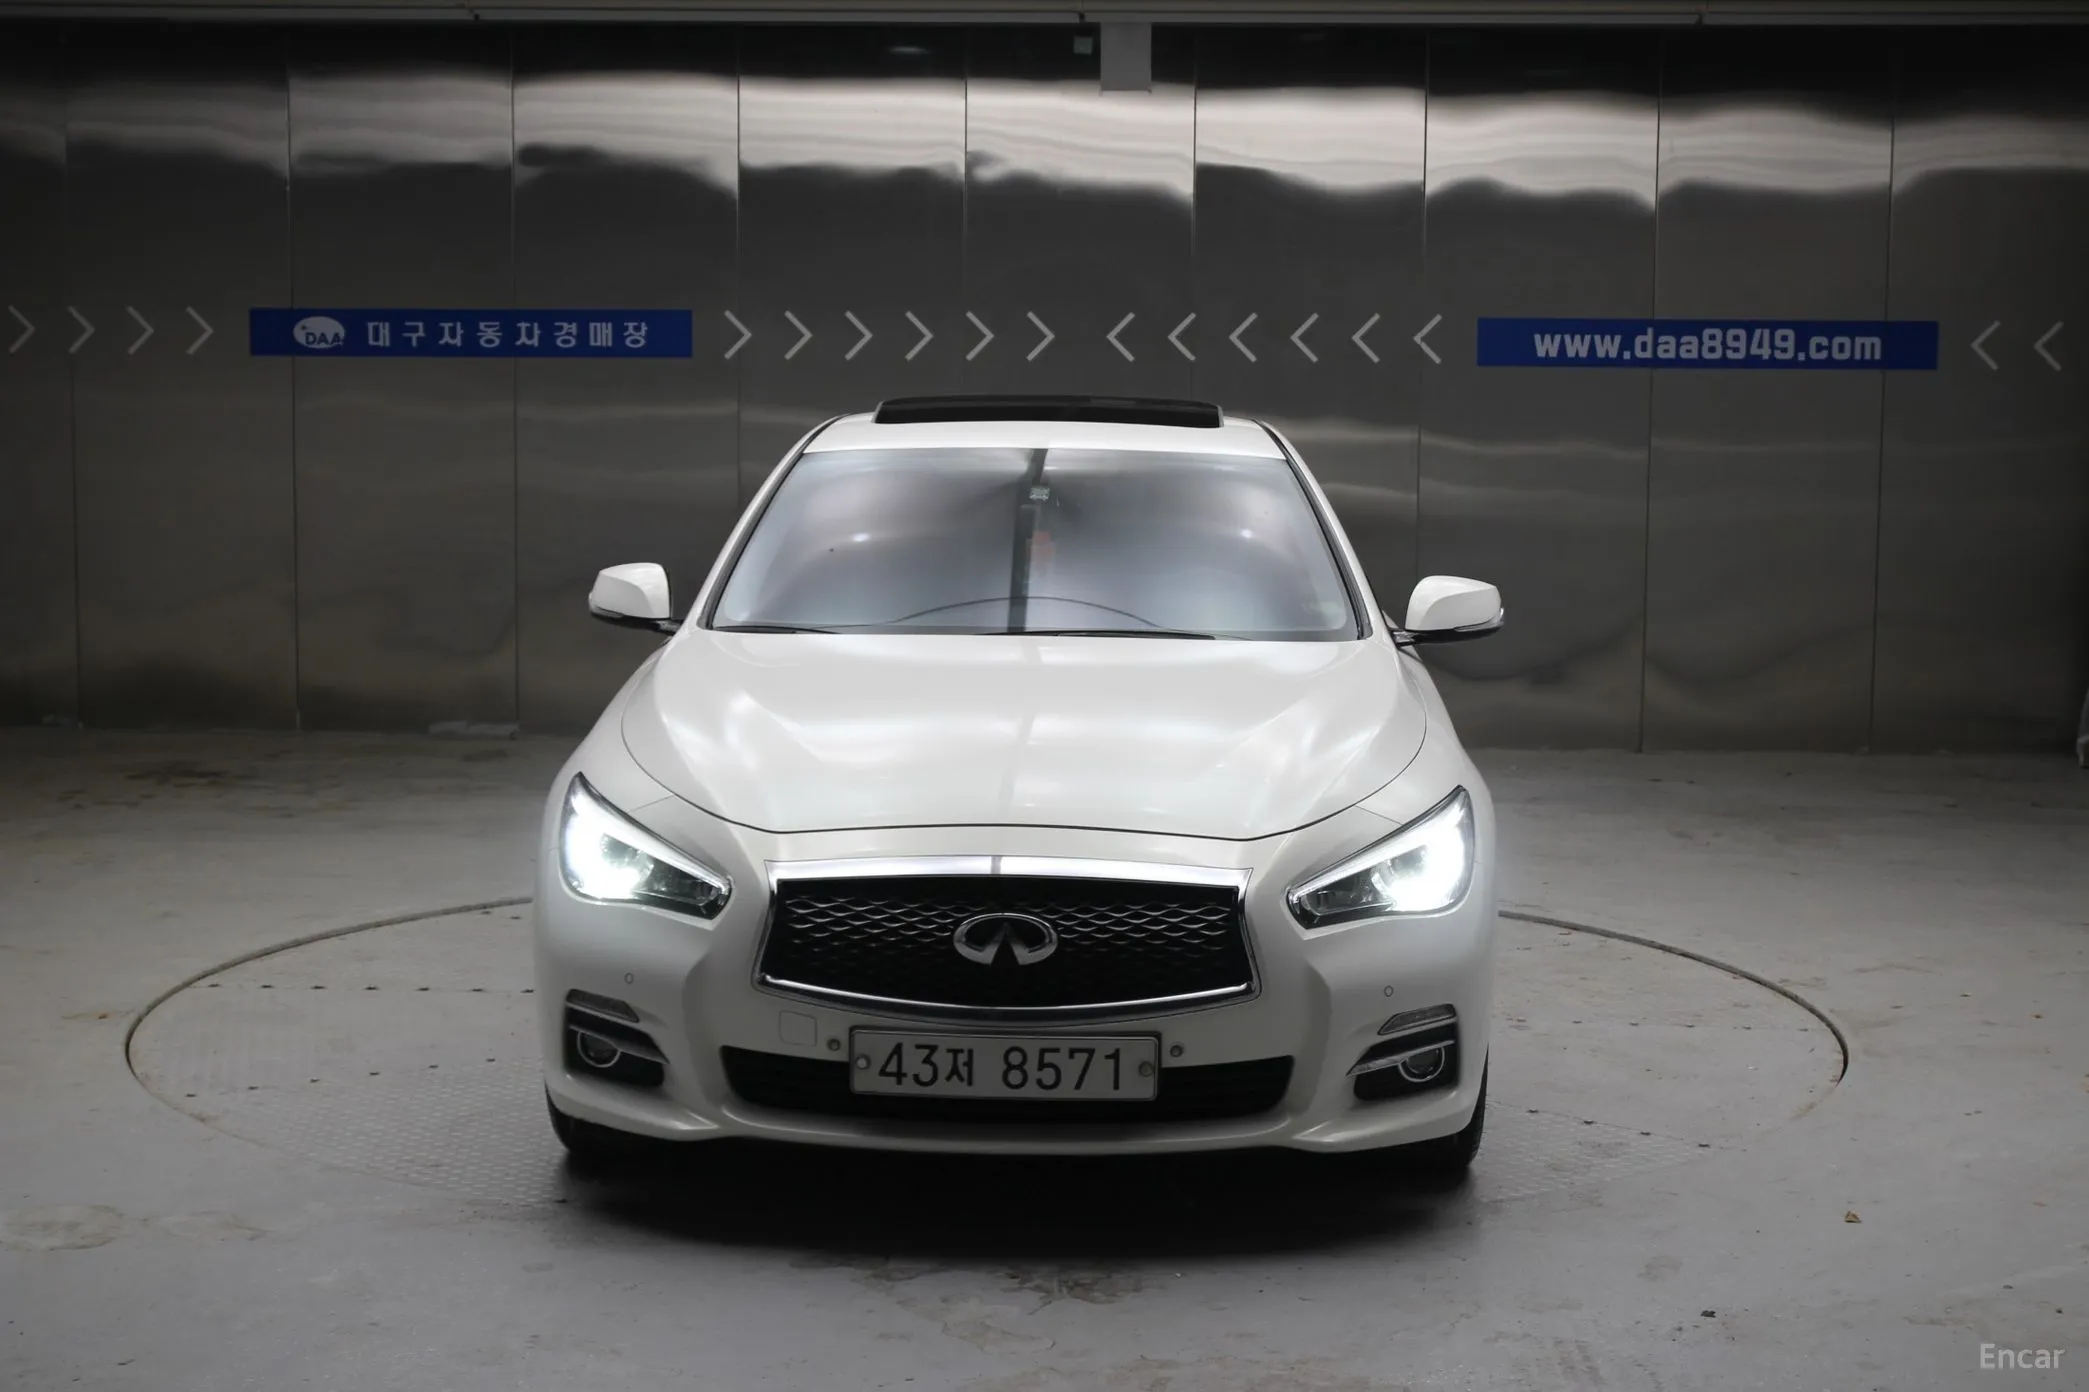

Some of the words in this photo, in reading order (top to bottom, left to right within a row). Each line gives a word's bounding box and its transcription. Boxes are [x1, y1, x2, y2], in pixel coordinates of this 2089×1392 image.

[304, 331, 343, 346] DAA
[367, 320, 649, 348] 대구자동차경매장
[1533, 327, 1882, 361] www.daa8949.com
[877, 1042, 975, 1087] 43저
[1001, 1045, 1121, 1091] 8571
